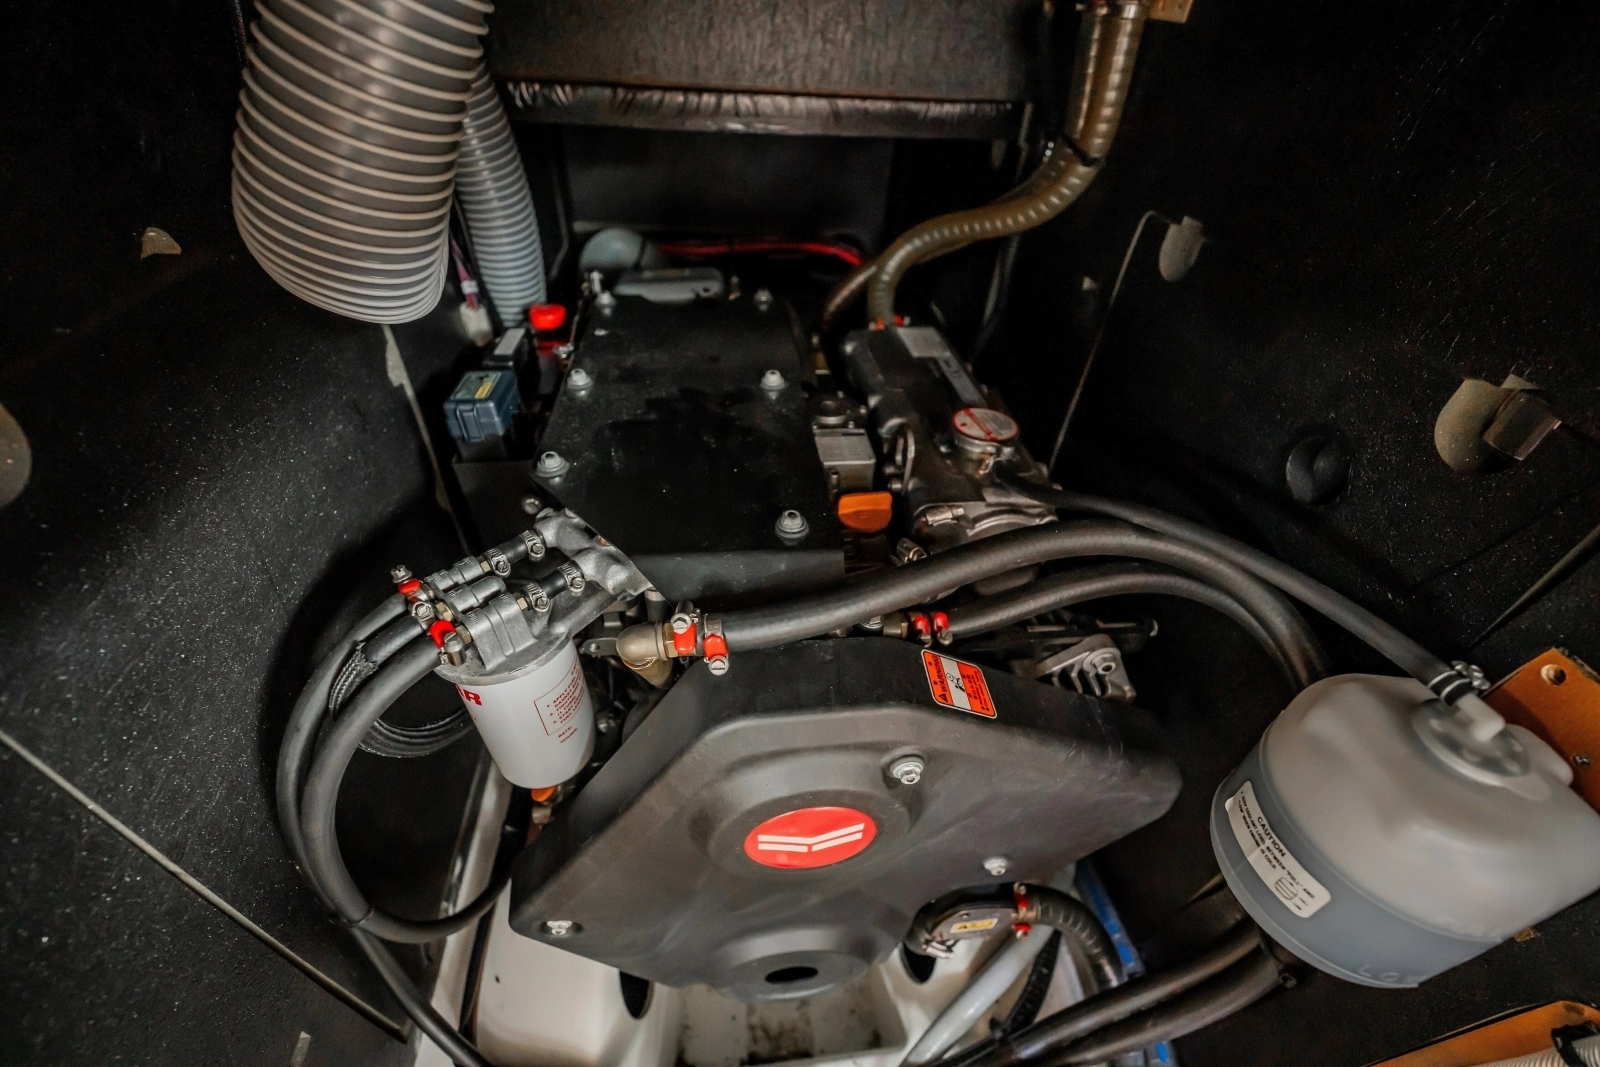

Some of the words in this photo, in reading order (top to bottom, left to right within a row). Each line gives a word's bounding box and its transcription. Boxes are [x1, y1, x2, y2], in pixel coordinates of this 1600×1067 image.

[932, 654, 948, 693] WARNING
[1242, 814, 1250, 830] WHEN
[1249, 829, 1261, 848] ENGINE
[1245, 807, 1258, 830] COOLANT
[1255, 829, 1266, 845] LEVEL
[1266, 845, 1286, 870] BETWEEN
[1257, 816, 1286, 857] CAUTION
